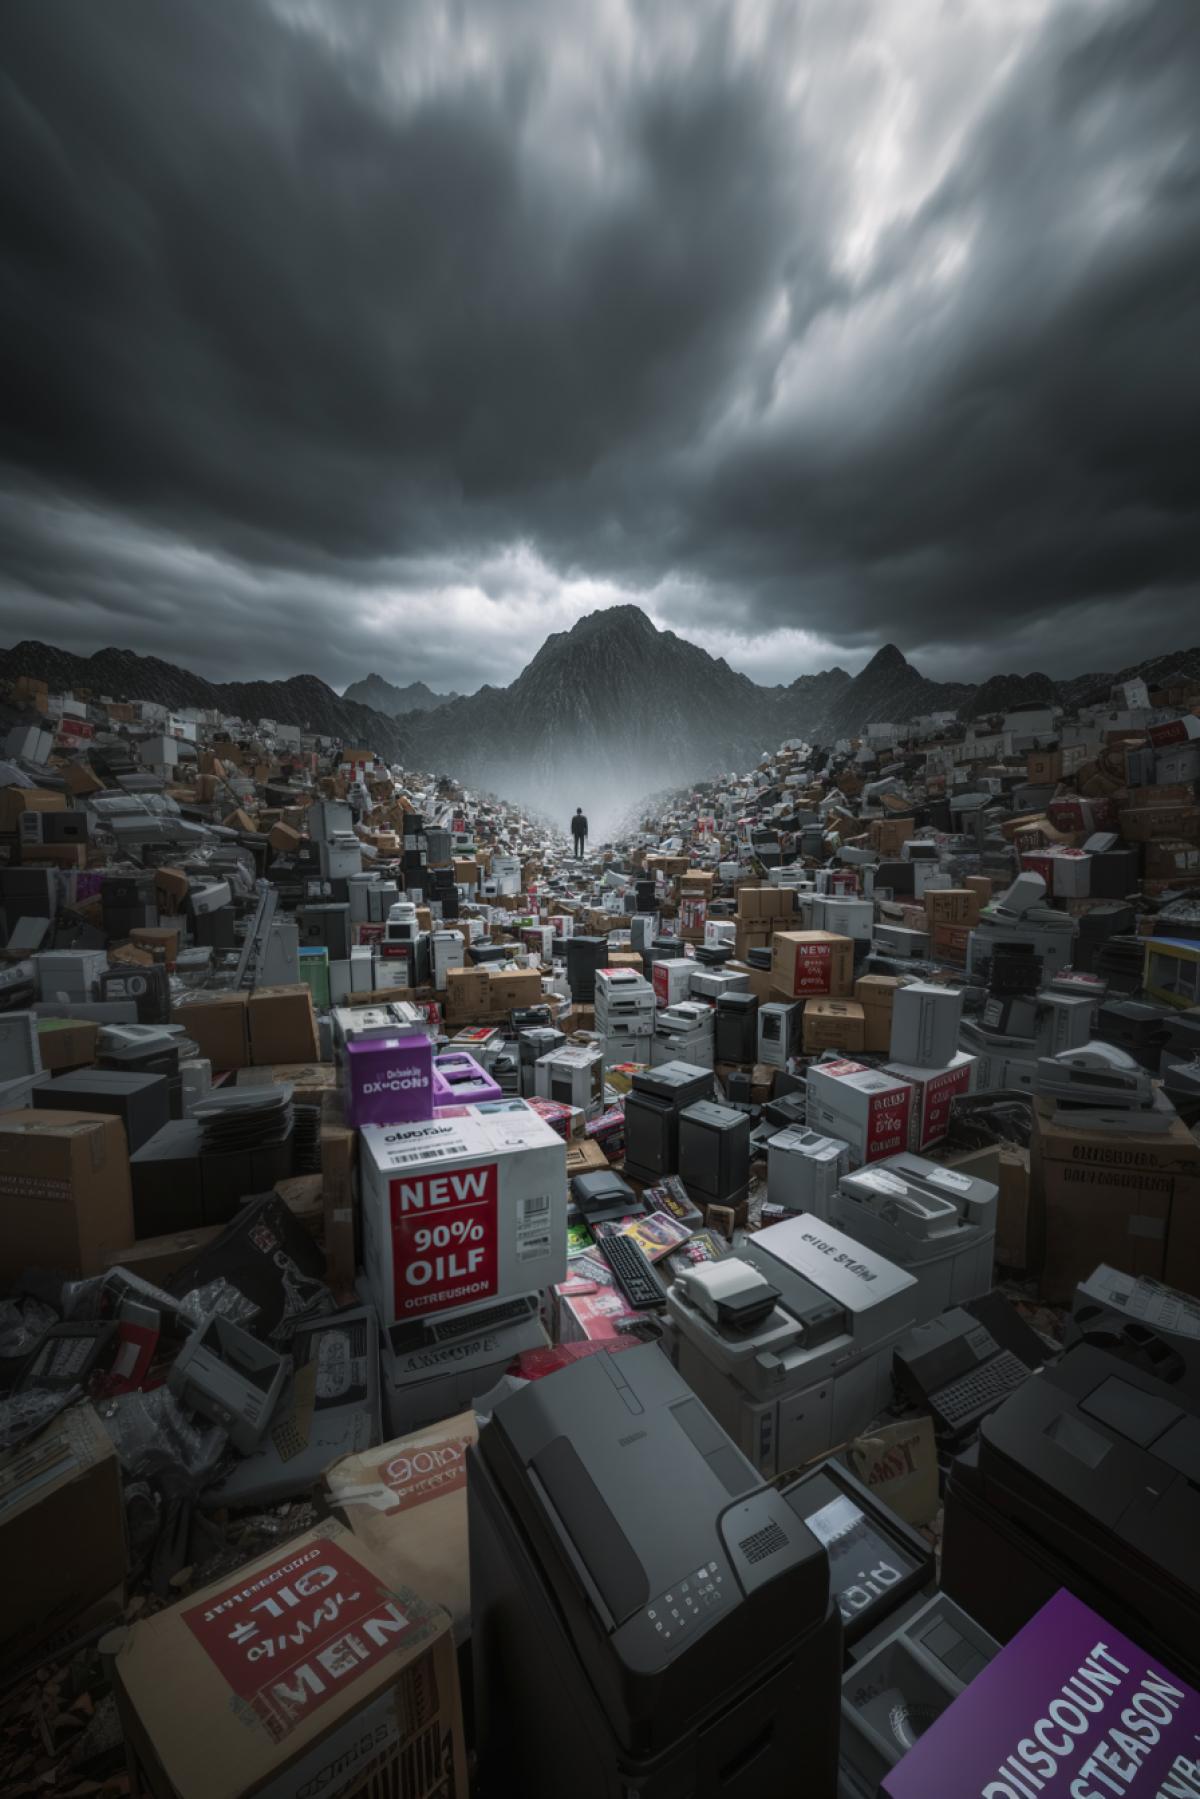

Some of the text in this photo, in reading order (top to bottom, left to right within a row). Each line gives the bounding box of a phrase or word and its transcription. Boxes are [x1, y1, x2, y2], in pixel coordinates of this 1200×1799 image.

[400, 1171, 489, 1212] NEW
[414, 1218, 485, 1252] 90%
[405, 1248, 485, 1286] OILF
